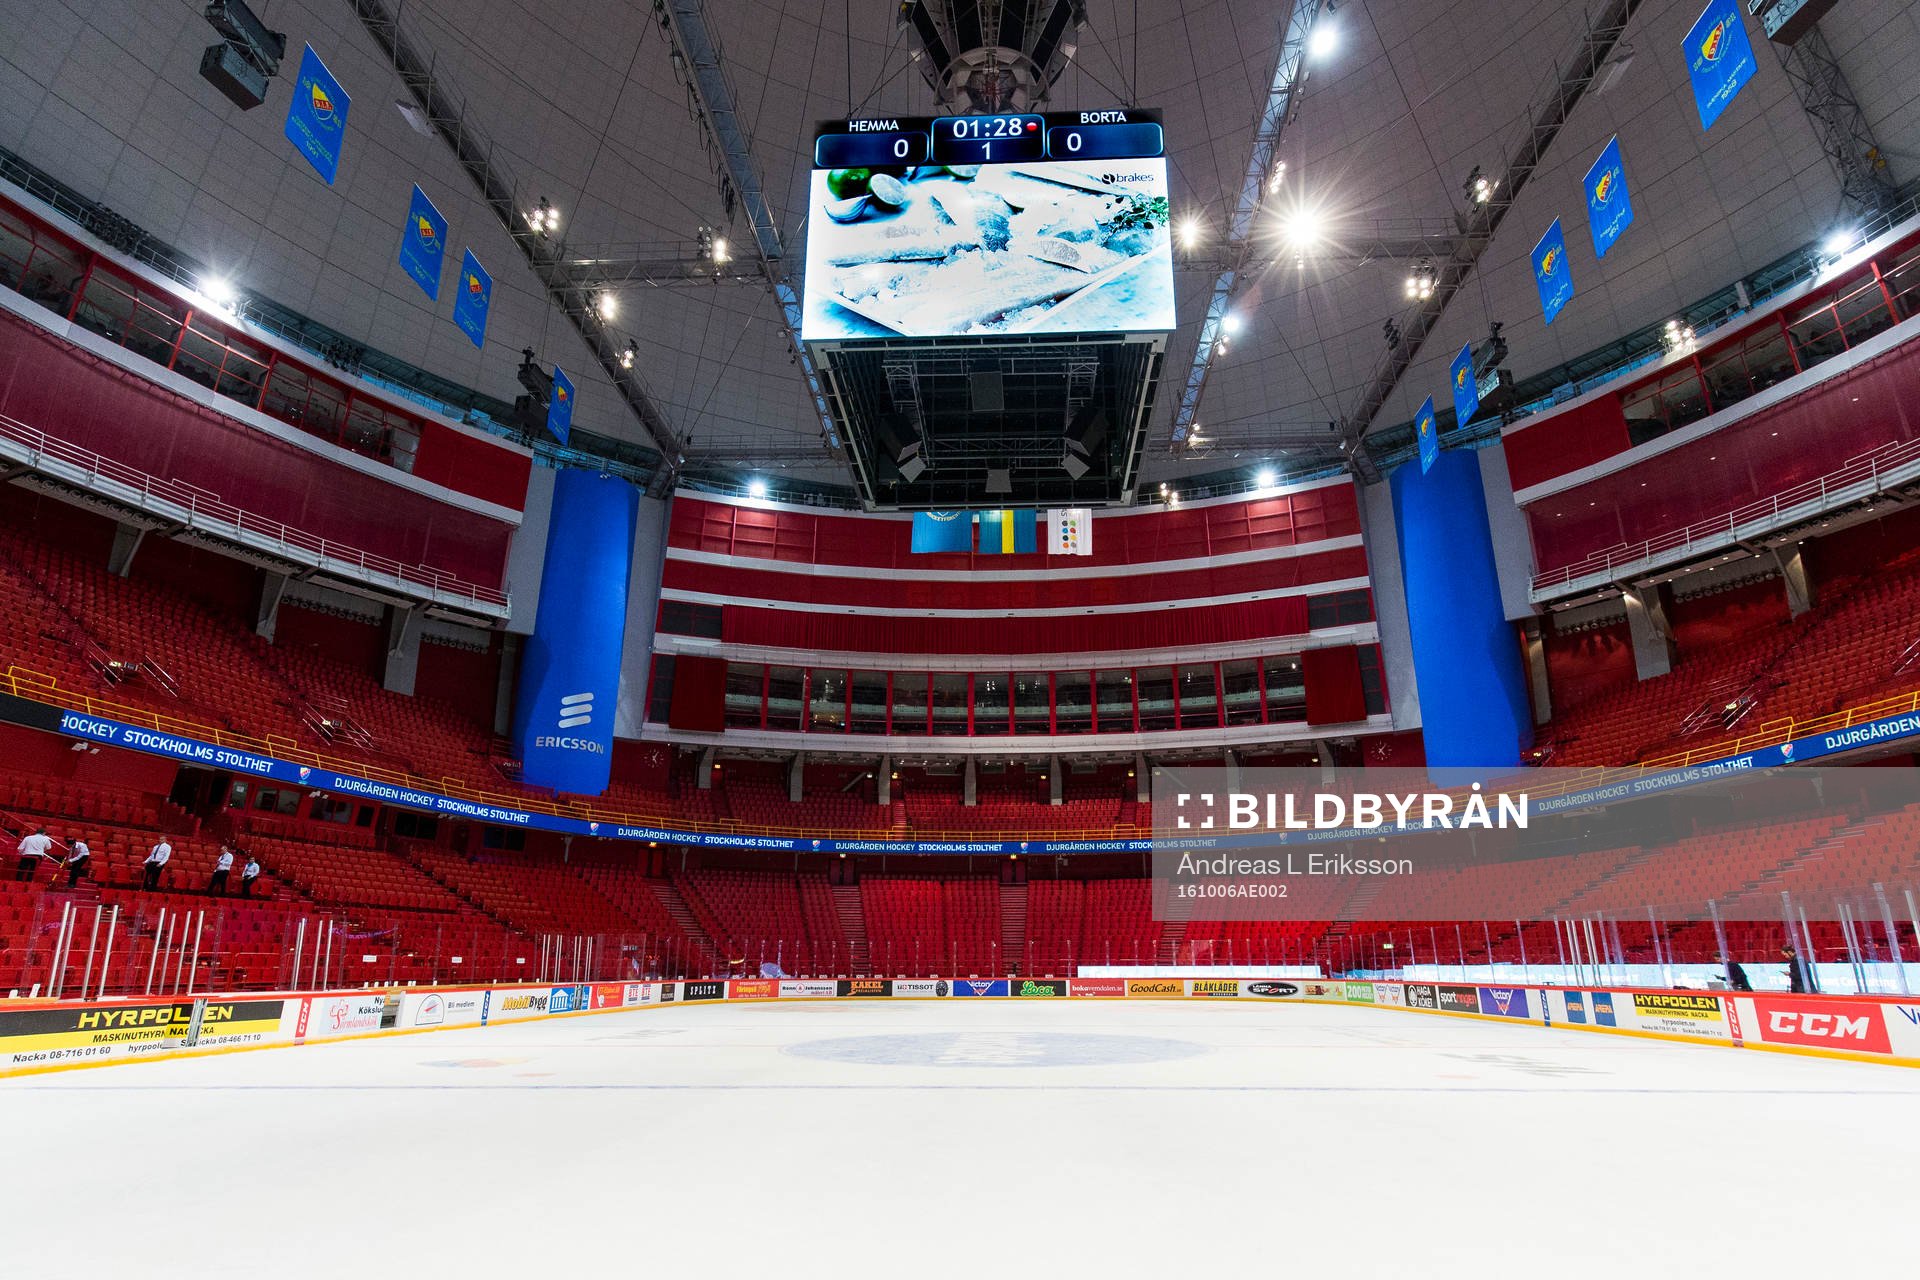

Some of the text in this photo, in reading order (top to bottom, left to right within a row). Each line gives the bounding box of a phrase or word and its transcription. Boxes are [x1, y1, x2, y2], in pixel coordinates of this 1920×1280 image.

[848, 119, 899, 132] HEMMA
[1080, 111, 1127, 124] BORTA
[952, 117, 1023, 139] 01:28
[893, 139, 909, 158] 0
[981, 142, 991, 160] 1
[1066, 133, 1082, 152] 0
[1116, 171, 1154, 183] brakes
[123, 730, 214, 760] STOCKHOLMS
[215, 751, 274, 773] STOLTHET
[535, 736, 604, 754] ERICSSON
[1538, 756, 1753, 811] DJURGÅRDEN HOCKEY STOCKHOLMS STOLTHET
[334, 777, 530, 824] DJURGÅRDEN HOCKEY STOCKHOLMS STOLTHET
[618, 828, 794, 848] DJURGÅRDEN HOCKEY STOCKHOLMS STOLTHET
[835, 842, 885, 850] DJURGÅRDEN
[886, 843, 915, 851] HOCKEY
[1046, 839, 1217, 851] DJURGÅRDEN HOCKEY STOCKHOLMS STOLTHET
[1020, 981, 1055, 996] Leca
[1194, 980, 1238, 992] BLÅKLÄDER
[1635, 995, 1717, 1009] HYRPOOLEN
[298, 1002, 309, 1033] CCM
[1727, 1002, 1738, 1034] CCM
[1768, 1010, 1870, 1040] CCM
[13, 1046, 111, 1063] Nacka 08-716 01 60
